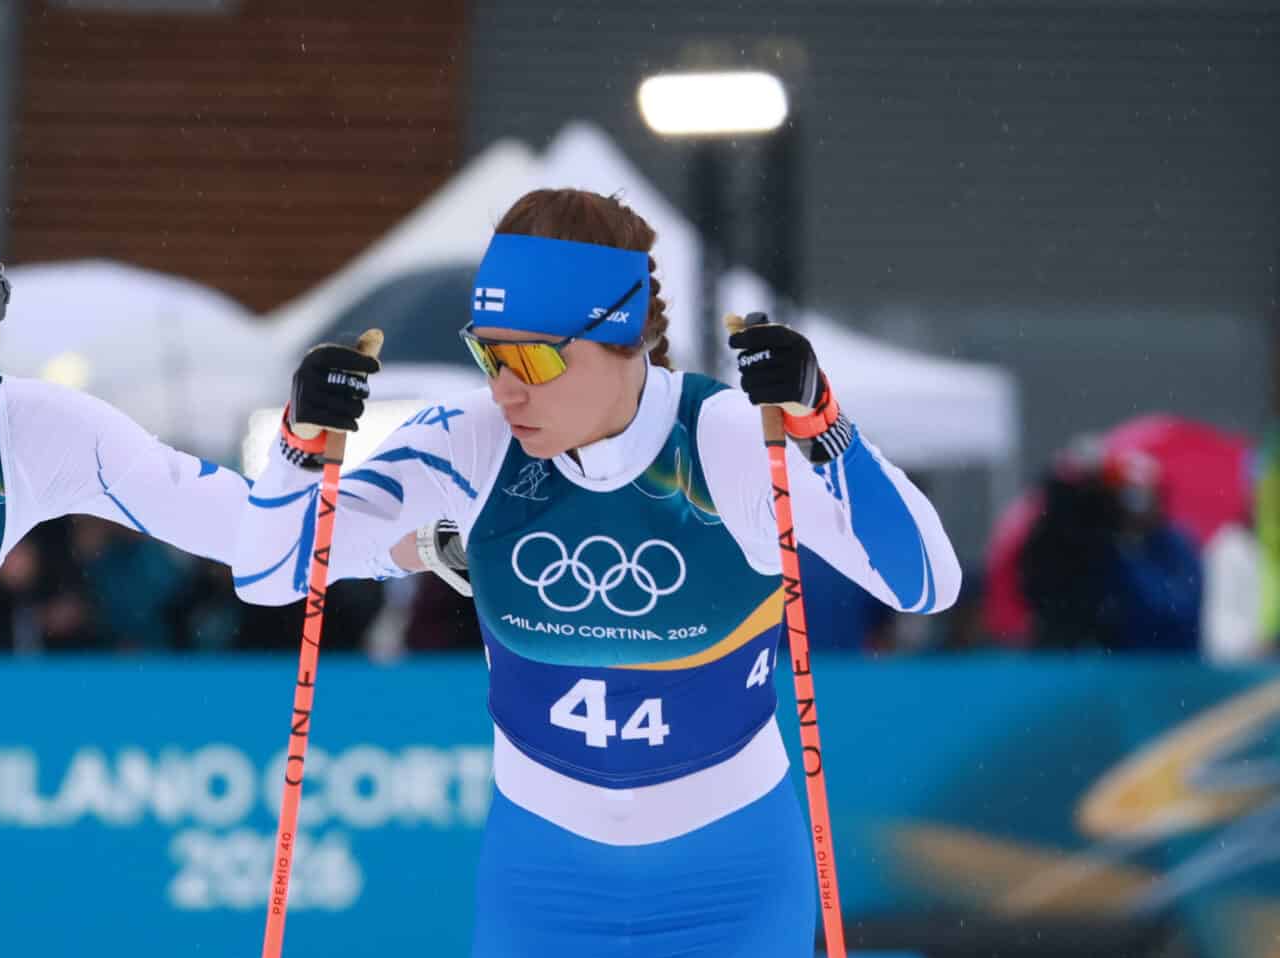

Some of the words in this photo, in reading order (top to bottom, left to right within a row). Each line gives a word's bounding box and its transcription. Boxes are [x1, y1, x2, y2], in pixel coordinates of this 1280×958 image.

[502, 614, 575, 638] MILANO
[578, 626, 664, 640] CORTINA
[669, 624, 708, 640] 2026
[746, 646, 776, 688] 4
[272, 857, 289, 914] PREMIO
[817, 851, 833, 909] PREMIO
